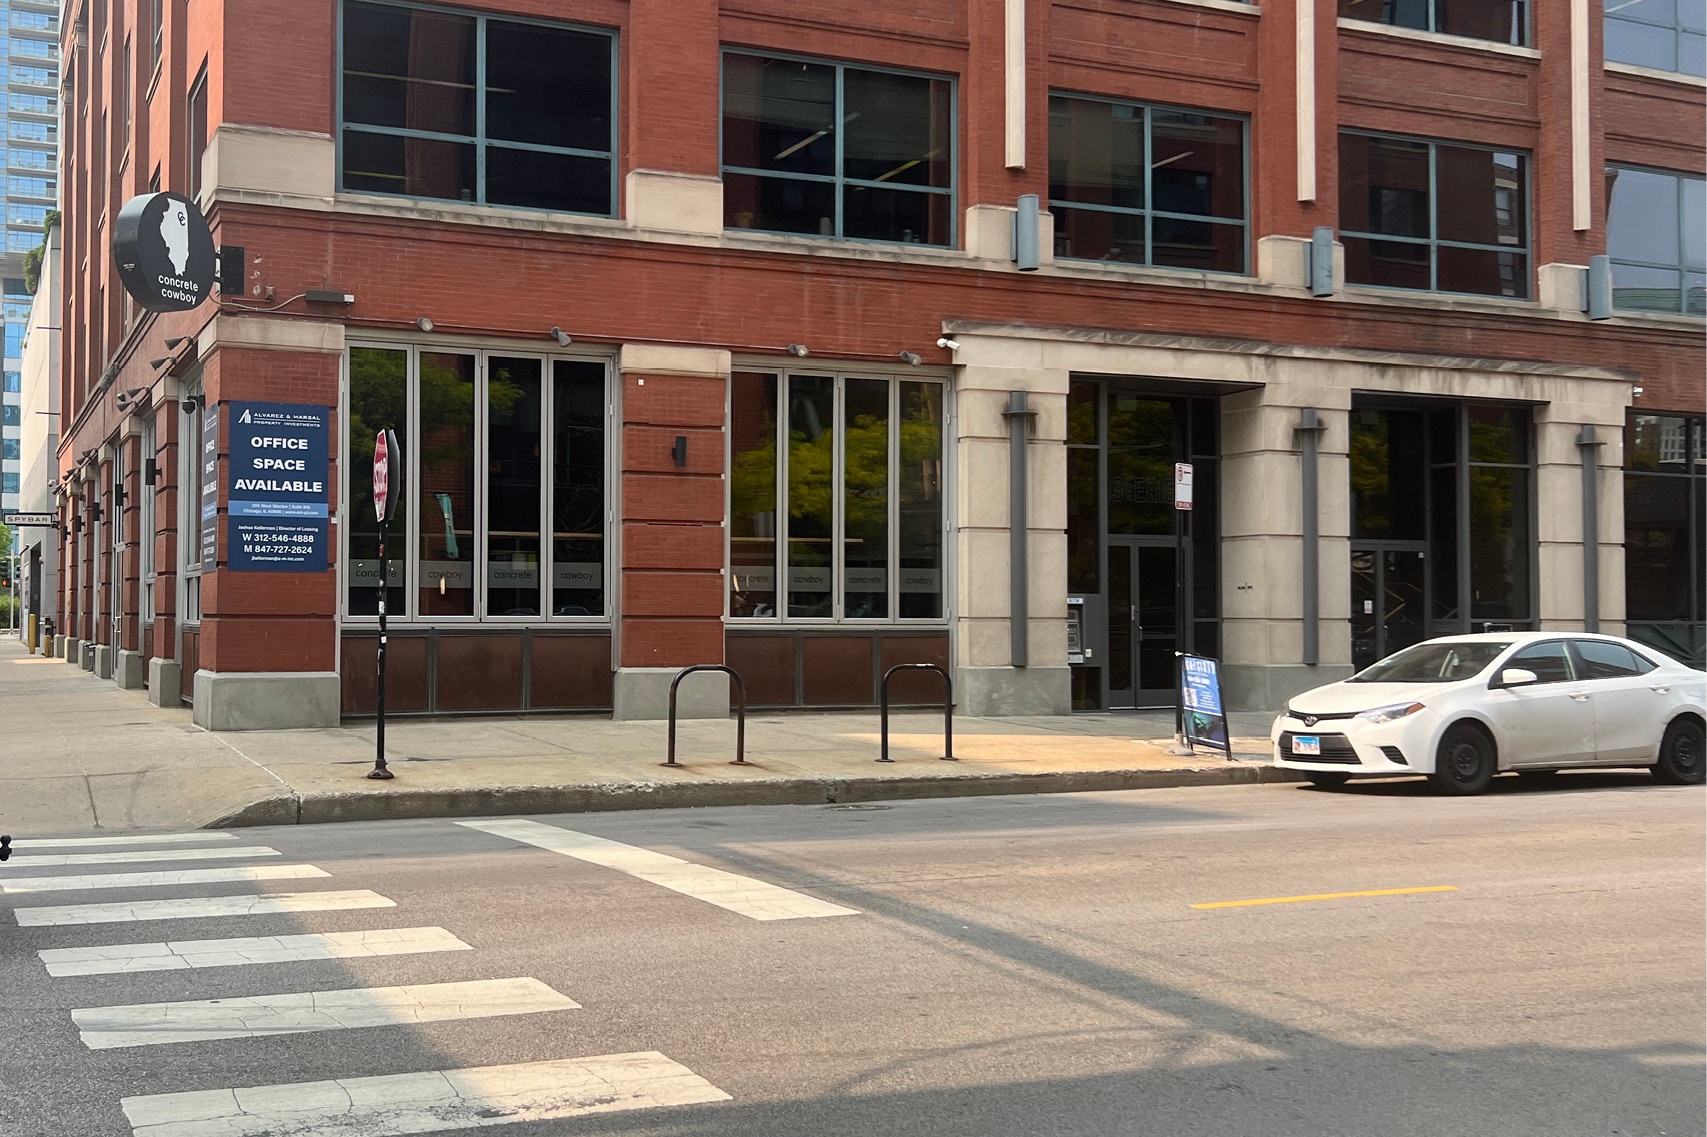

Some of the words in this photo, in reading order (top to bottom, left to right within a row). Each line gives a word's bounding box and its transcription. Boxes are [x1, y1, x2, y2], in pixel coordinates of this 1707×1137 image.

[158, 275, 199, 292] concrete
[161, 288, 197, 305] cowboy
[250, 436, 309, 450] OFFICE
[252, 458, 306, 471] SPACE
[234, 478, 323, 493] AVAILABLE
[242, 533, 252, 541] W
[253, 533, 314, 543] 312-546-4888
[243, 544, 253, 553] M
[254, 545, 313, 554] 847-727-2624
[355, 569, 397, 578] concte
[427, 570, 463, 581] cowboy
[493, 570, 532, 580] concrete
[560, 571, 593, 581] cowboy
[793, 574, 824, 585] cowboy
[848, 576, 882, 584] concrete
[905, 576, 934, 586] cowboy
